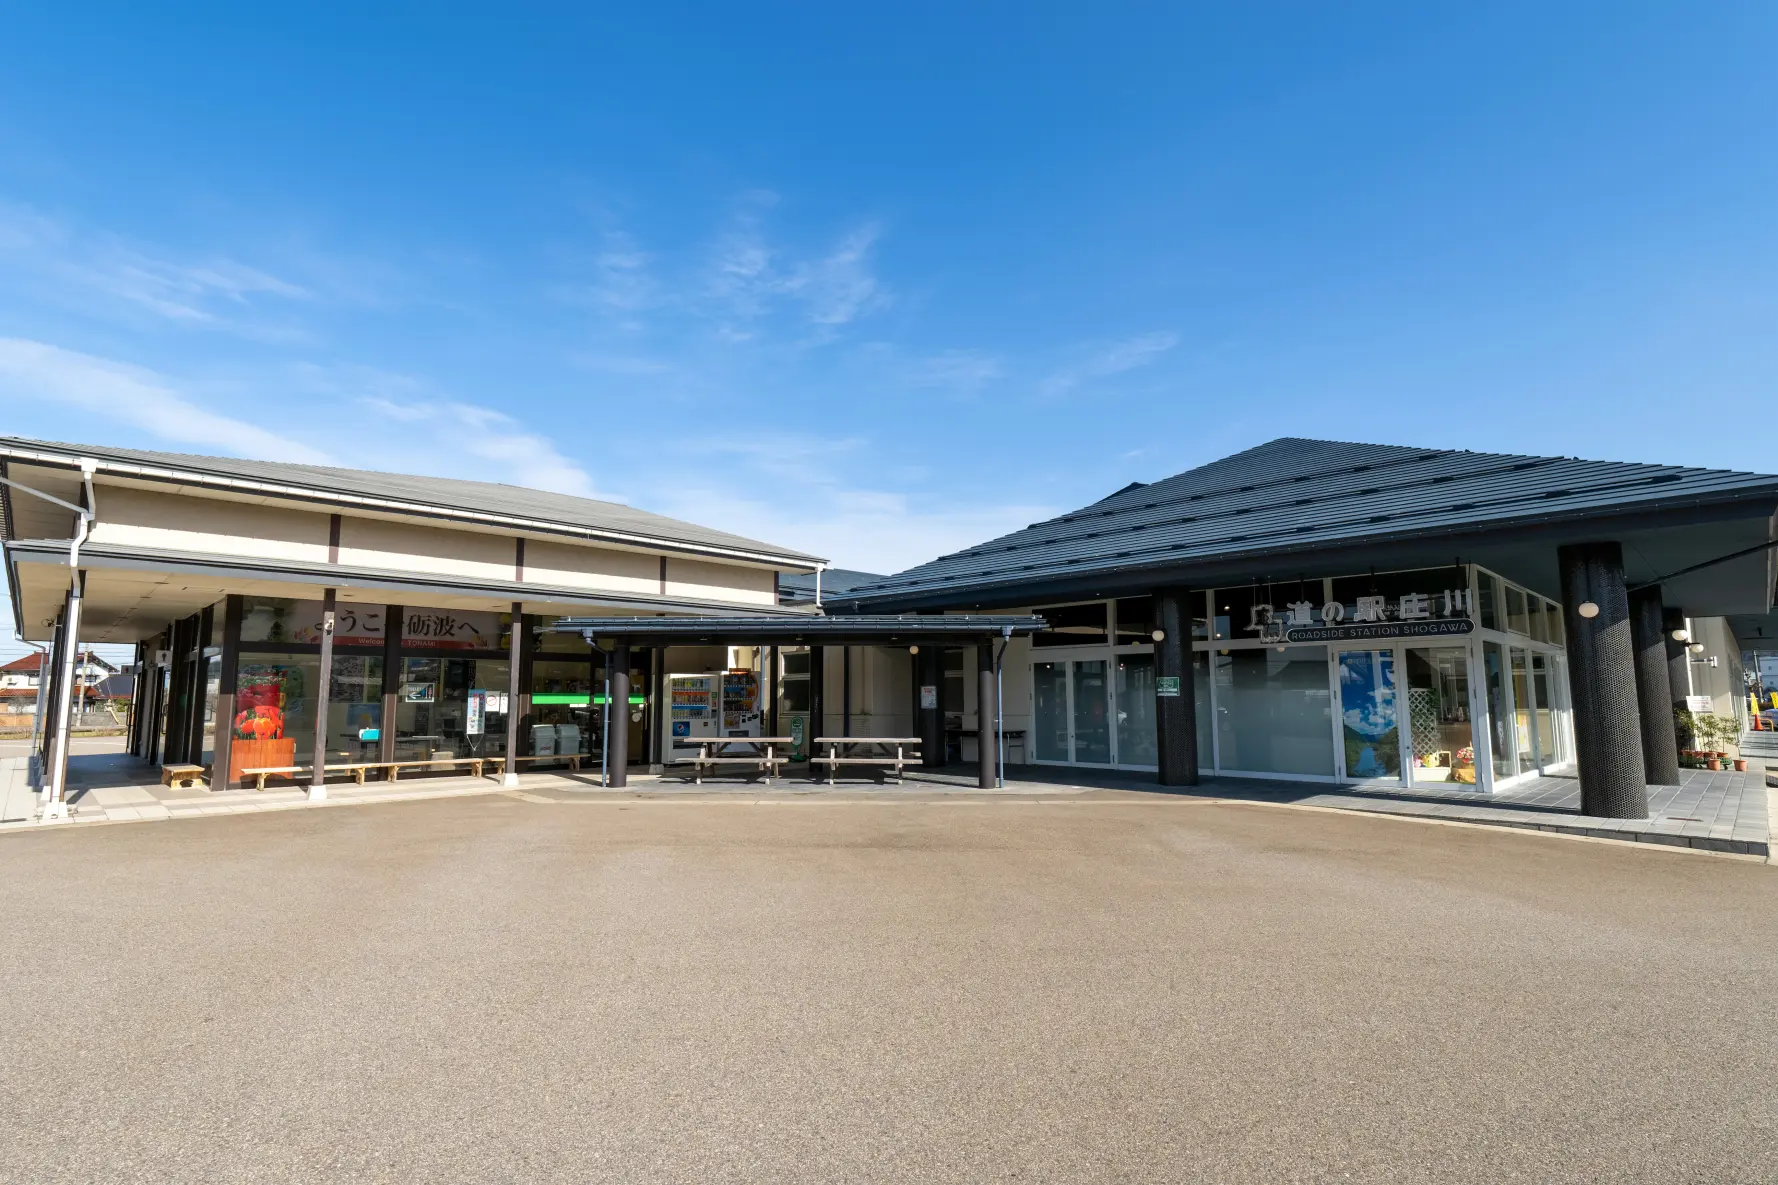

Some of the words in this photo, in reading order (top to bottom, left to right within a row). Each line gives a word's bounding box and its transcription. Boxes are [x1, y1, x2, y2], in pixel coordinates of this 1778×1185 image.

[1286, 588, 1474, 626] 道の駅庄川
[314, 609, 481, 638] うこ砺波へ
[1291, 629, 1345, 640] ROADSIDE
[1350, 626, 1400, 637] STATION
[1403, 622, 1468, 634] SHOGAWA
[407, 639, 436, 647] TONAMI
